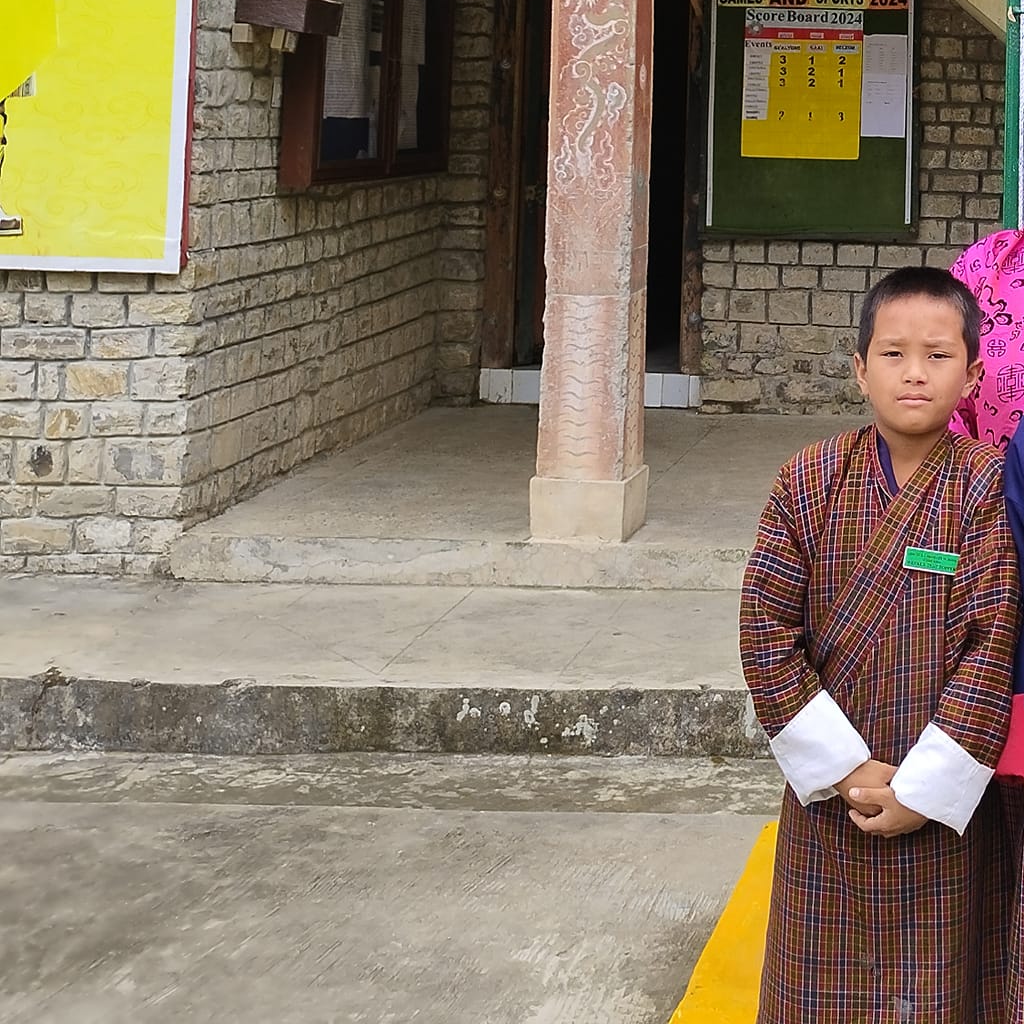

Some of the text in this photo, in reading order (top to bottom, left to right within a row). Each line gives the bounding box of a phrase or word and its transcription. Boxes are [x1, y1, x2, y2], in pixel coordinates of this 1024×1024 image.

[746, 9, 863, 25] Score Board 2024
[745, 40, 773, 48] Events
[779, 55, 846, 65] 3 1 2
[779, 67, 844, 77] 3 2 1
[779, 79, 843, 88] 3 2 1
